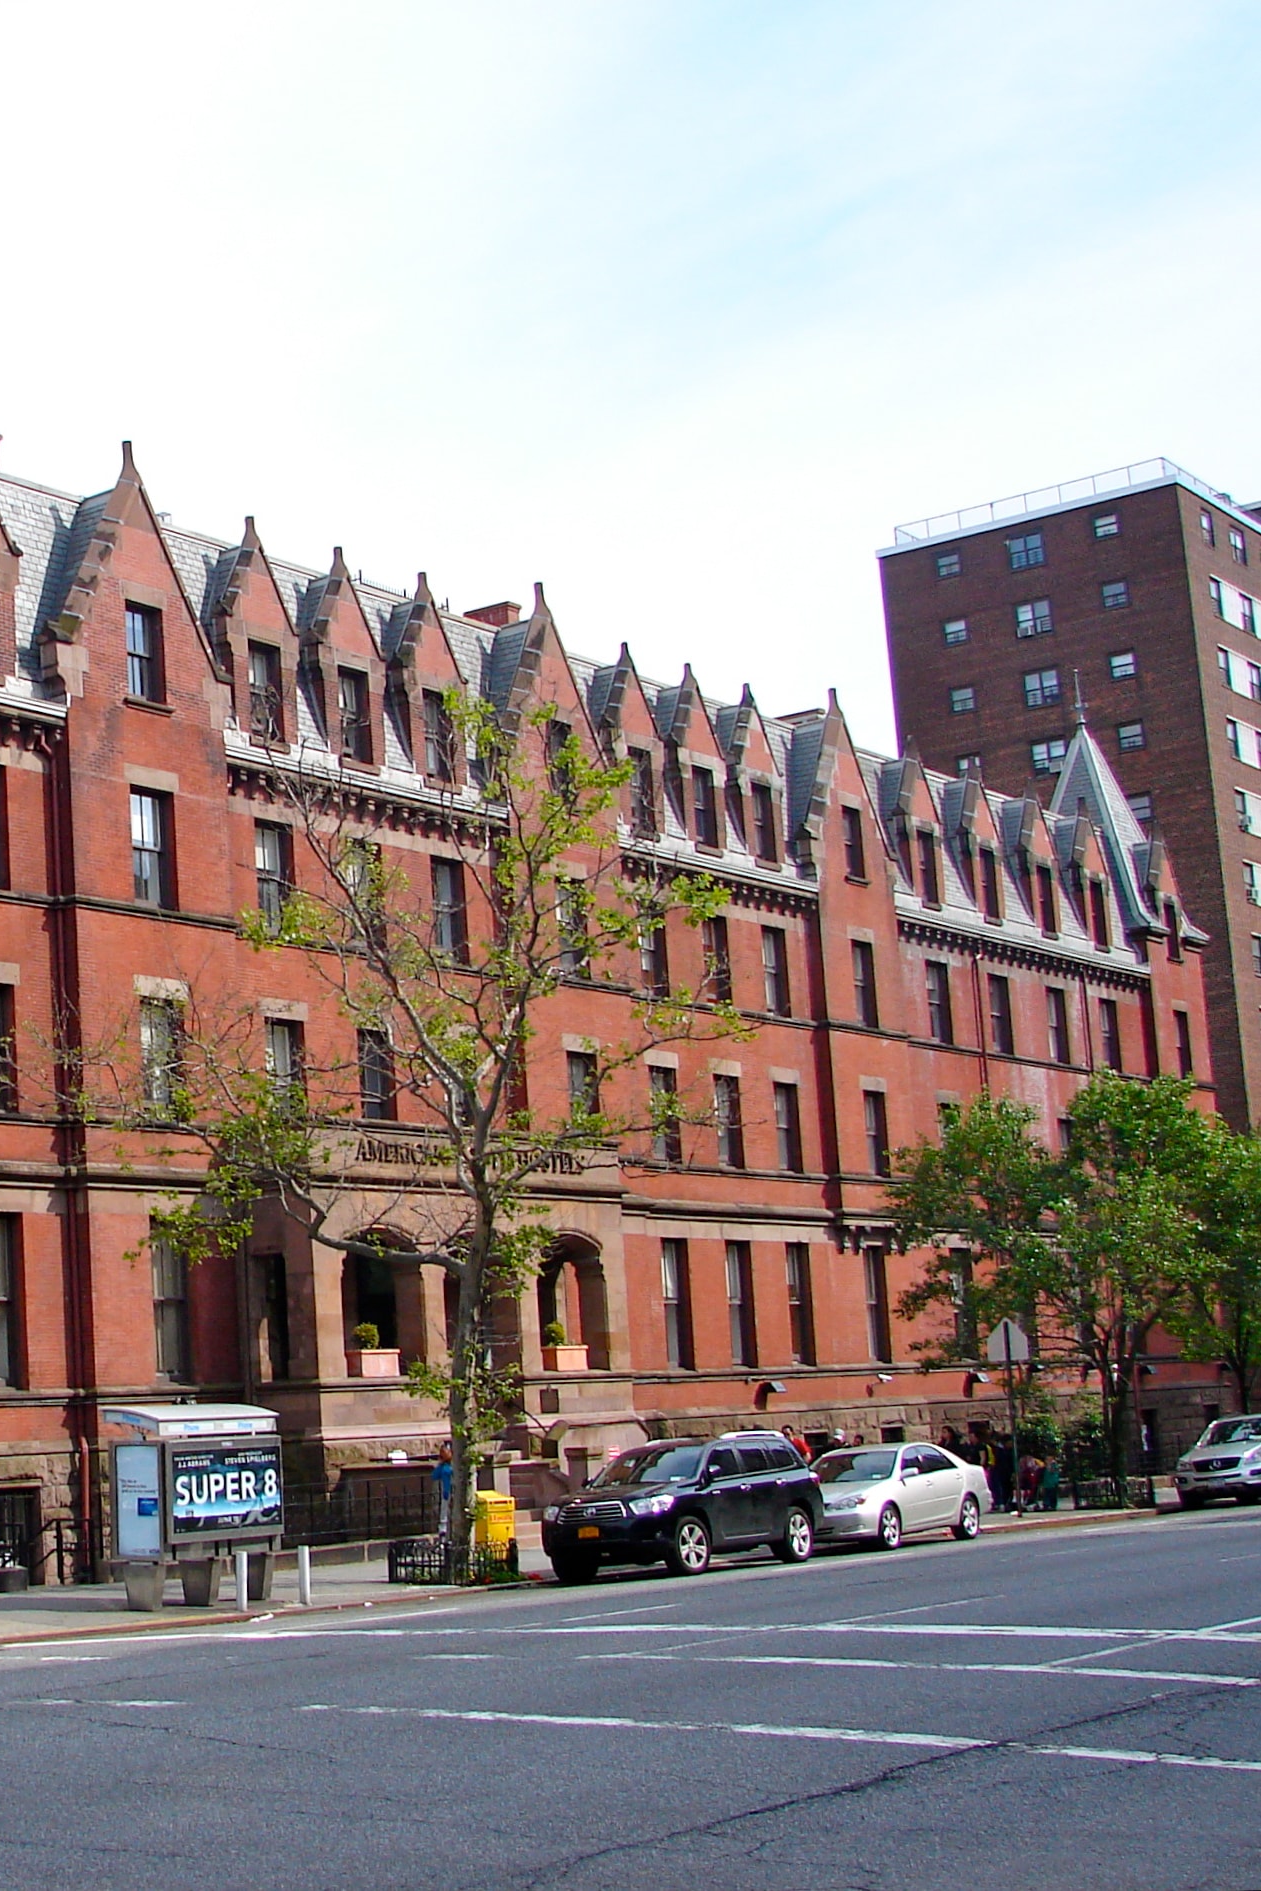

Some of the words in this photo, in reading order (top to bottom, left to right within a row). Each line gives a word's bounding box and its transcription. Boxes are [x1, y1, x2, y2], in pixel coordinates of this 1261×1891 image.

[355, 1138, 452, 1167] AMERIC
[175, 1469, 257, 1506] SUPER
[263, 1468, 277, 1498] 8
